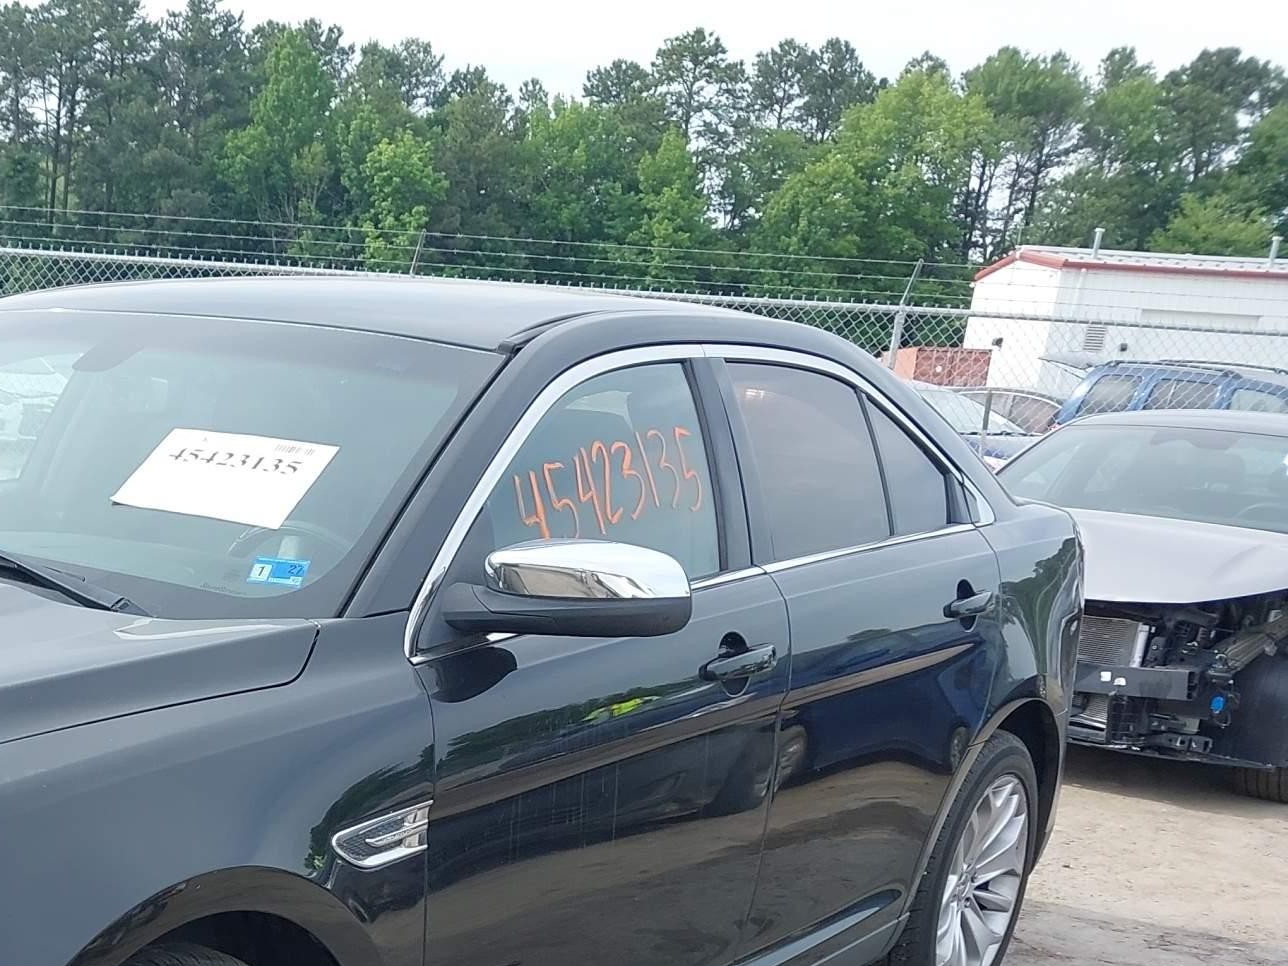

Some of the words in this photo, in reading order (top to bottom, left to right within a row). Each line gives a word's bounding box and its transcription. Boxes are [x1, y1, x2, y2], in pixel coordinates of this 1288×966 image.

[168, 447, 304, 475] 45423135
[513, 426, 702, 540] 45423135
[257, 565, 265, 577] 1
